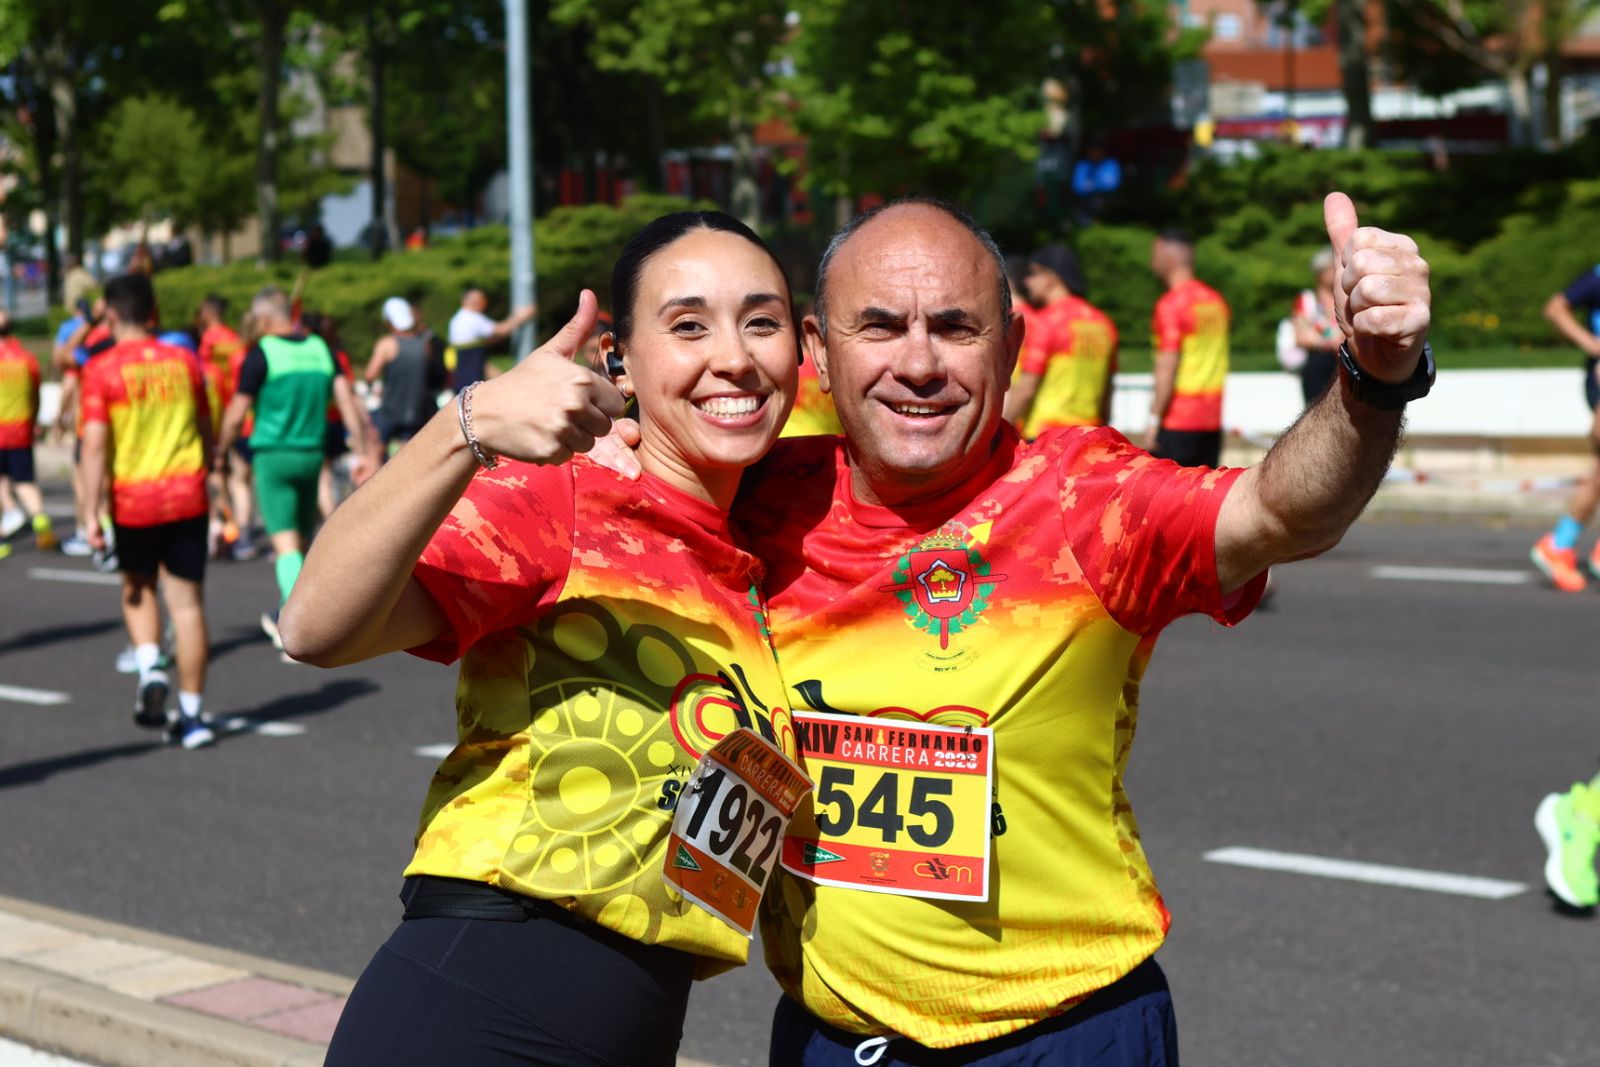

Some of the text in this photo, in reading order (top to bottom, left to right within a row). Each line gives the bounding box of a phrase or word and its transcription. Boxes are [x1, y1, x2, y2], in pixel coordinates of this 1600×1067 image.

[841, 741, 929, 766] CARRERA
[844, 727, 874, 745] SAN
[888, 730, 982, 752] FERNANDO
[740, 755, 785, 797] CARRERA
[686, 768, 782, 888] 1922
[814, 766, 955, 848] 545
